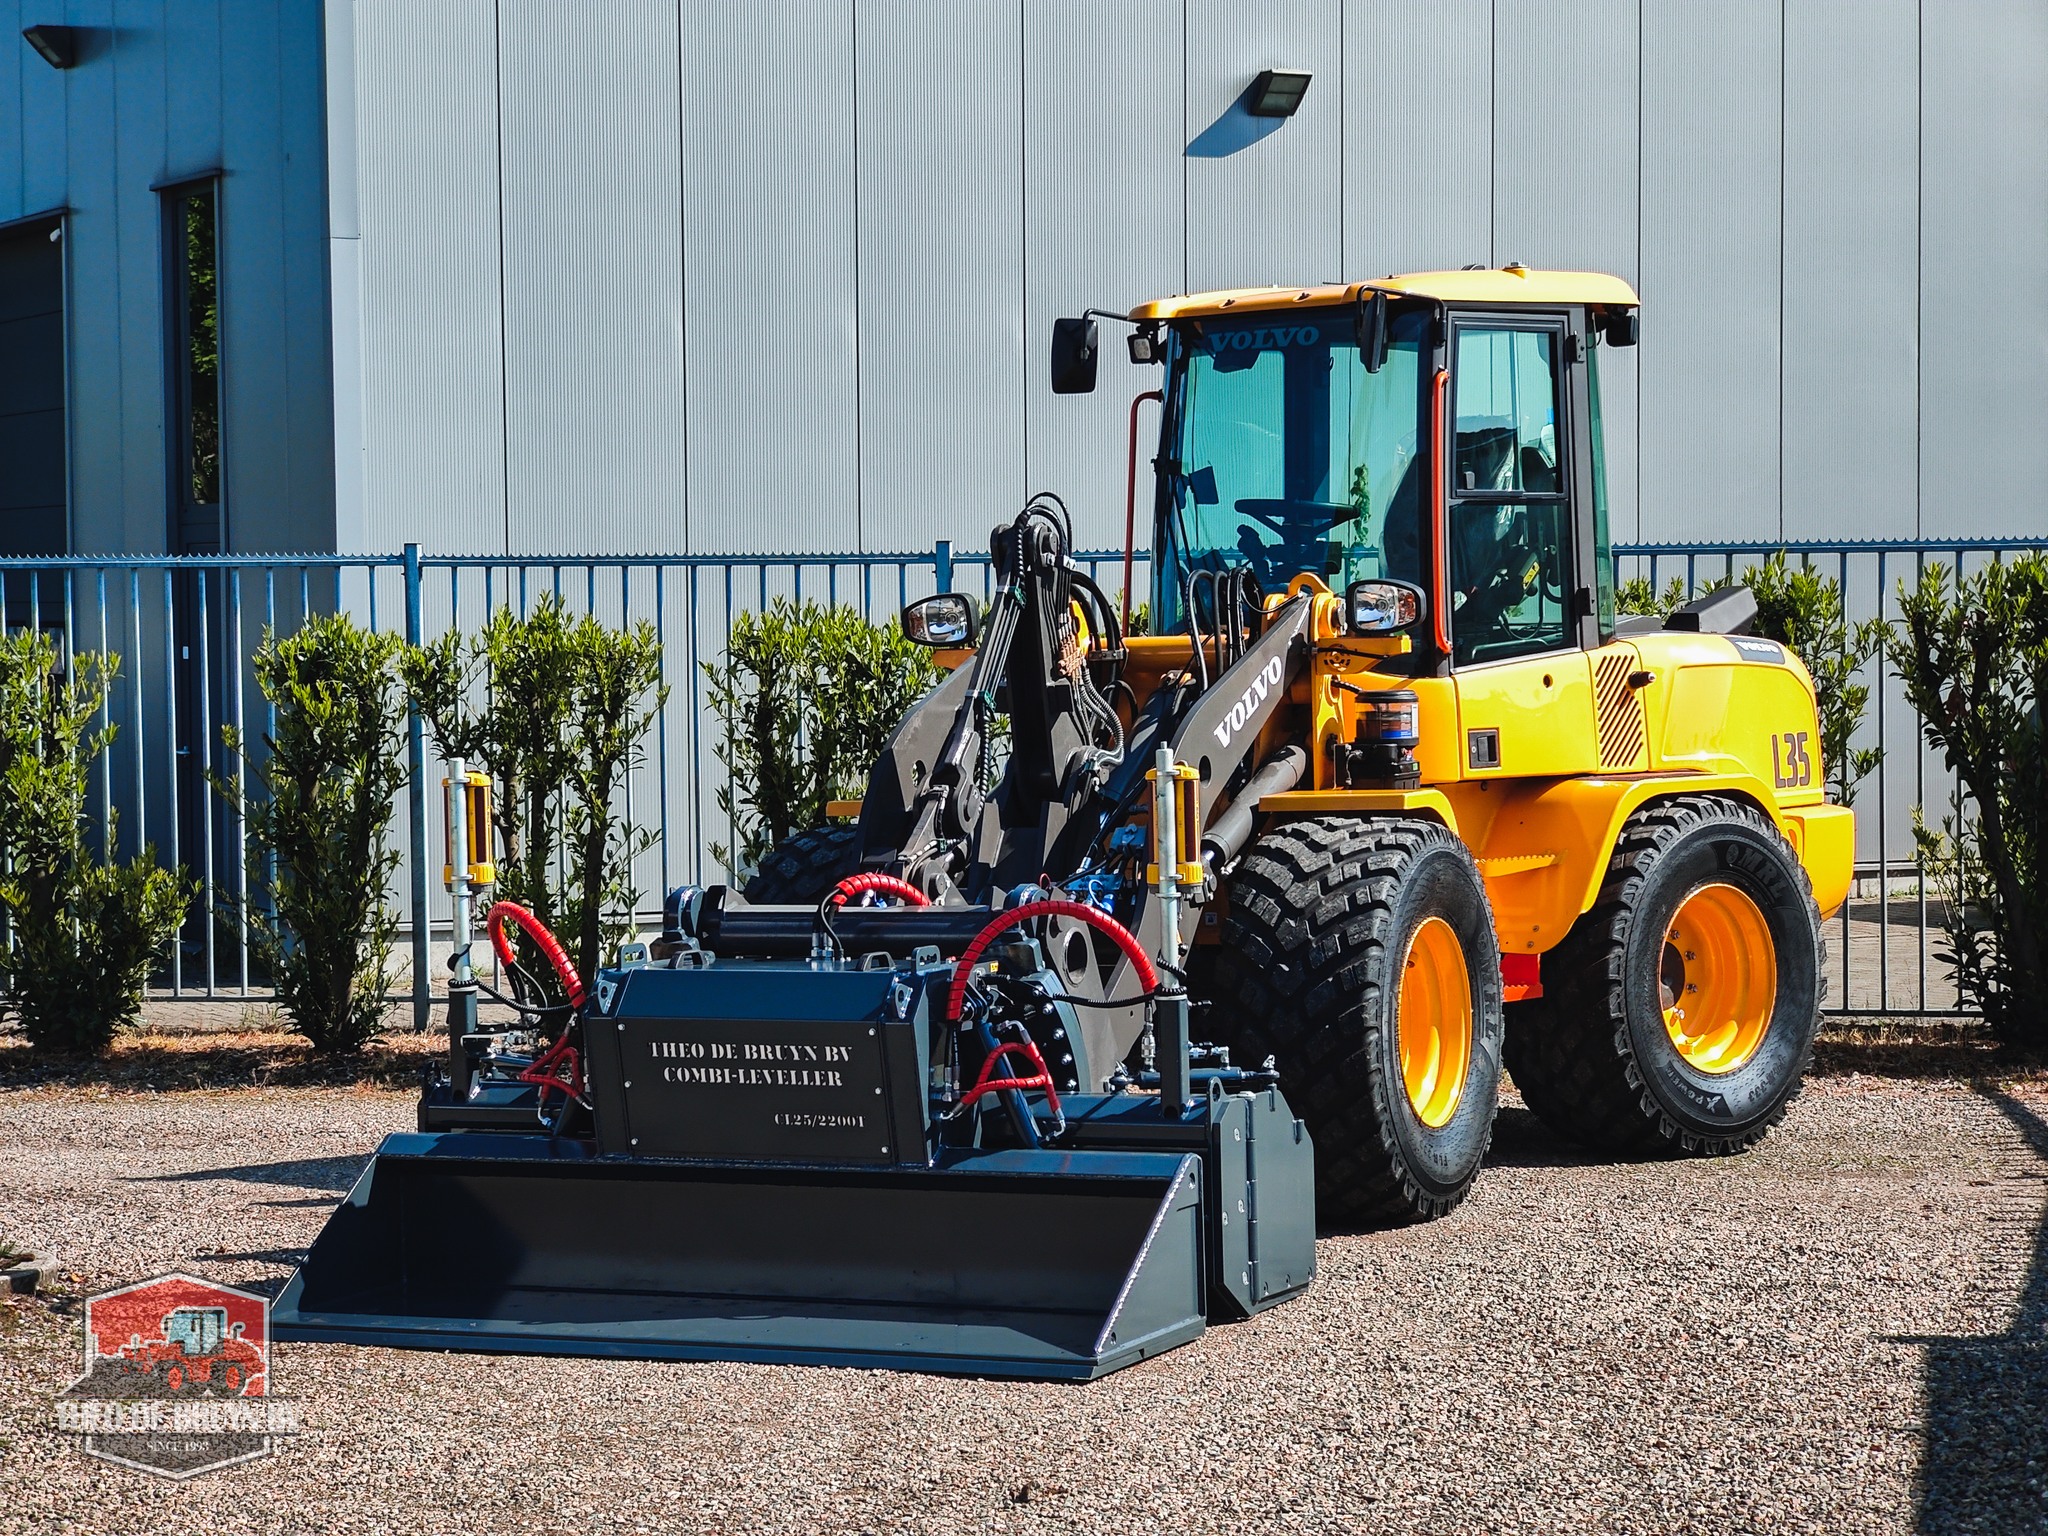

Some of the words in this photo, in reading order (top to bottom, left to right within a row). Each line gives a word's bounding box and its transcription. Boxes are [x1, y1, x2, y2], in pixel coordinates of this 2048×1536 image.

[1208, 326, 1319, 352] VOLVO
[1213, 655, 1282, 748] VOLVO
[1771, 731, 1811, 789] L35
[648, 1042, 705, 1059] THEO
[711, 1043, 738, 1060] DE
[744, 1044, 818, 1061] BRUYN
[825, 1046, 852, 1062] BV
[664, 1066, 843, 1086] COMBI-LEVELLER
